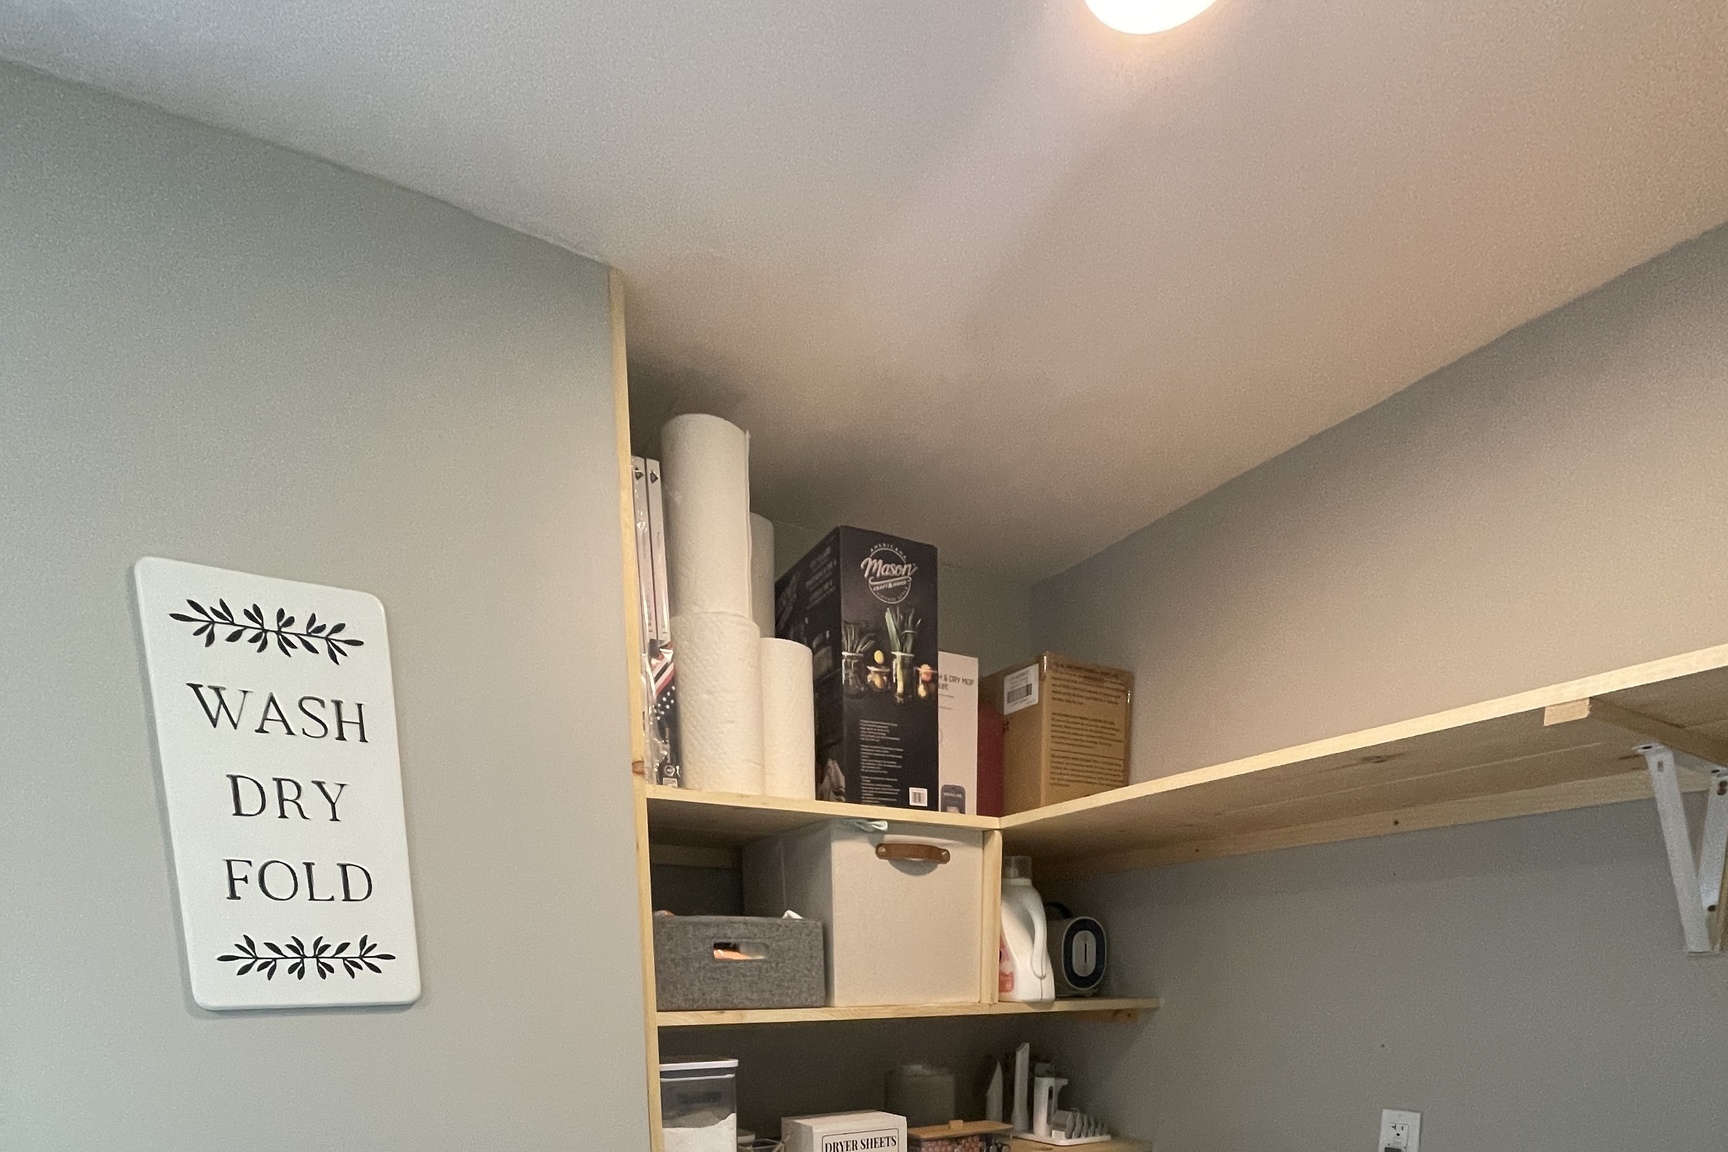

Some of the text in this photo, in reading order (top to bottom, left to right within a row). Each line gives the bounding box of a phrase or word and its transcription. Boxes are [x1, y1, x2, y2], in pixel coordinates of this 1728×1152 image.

[860, 557, 912, 579] Mason
[949, 675, 961, 684] DRY
[186, 682, 369, 743] WASH
[226, 773, 349, 822] DRY
[223, 858, 373, 902] FOLD
[860, 1135, 897, 1150] SHEETS
